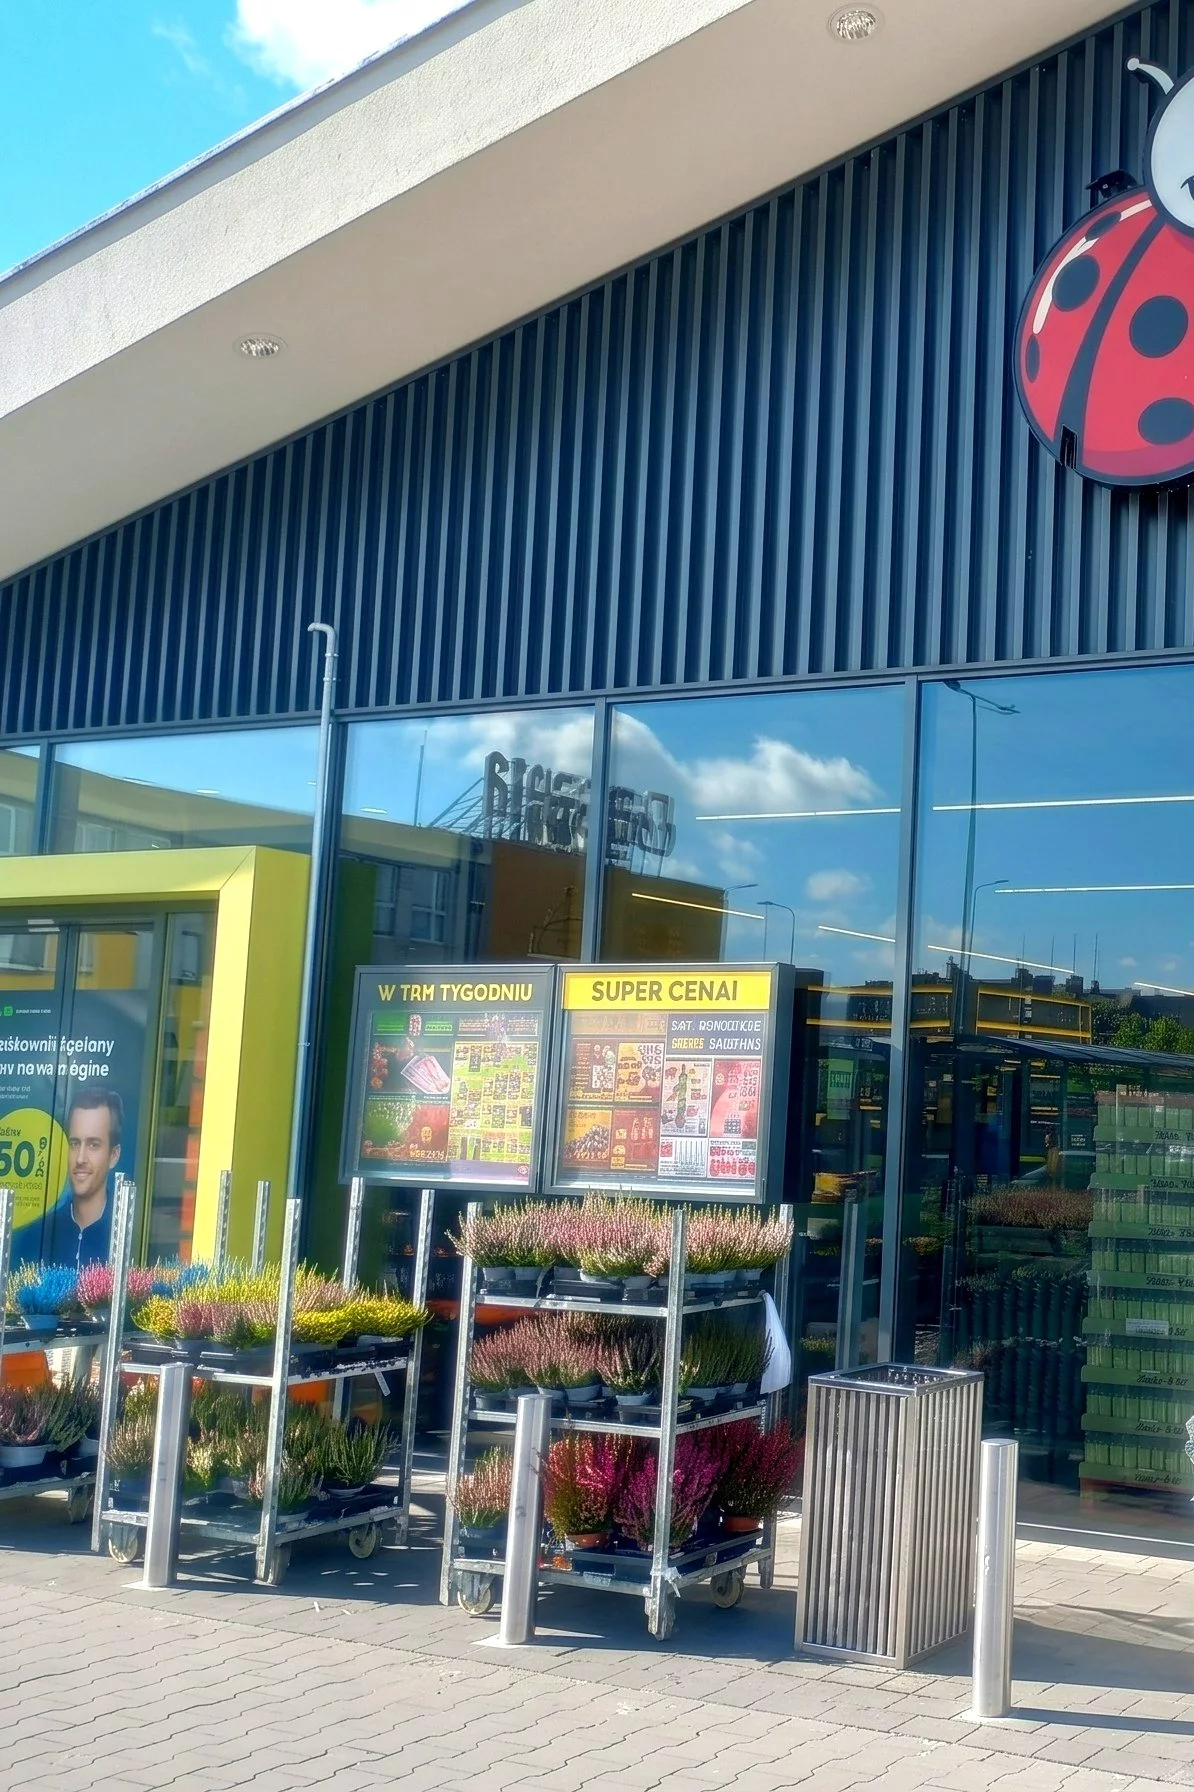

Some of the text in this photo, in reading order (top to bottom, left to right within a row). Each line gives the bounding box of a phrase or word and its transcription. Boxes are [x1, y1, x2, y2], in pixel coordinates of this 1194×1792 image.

[378, 984, 396, 1002] W
[440, 983, 533, 1002] TYGODNIU
[591, 980, 663, 1002] SUPER
